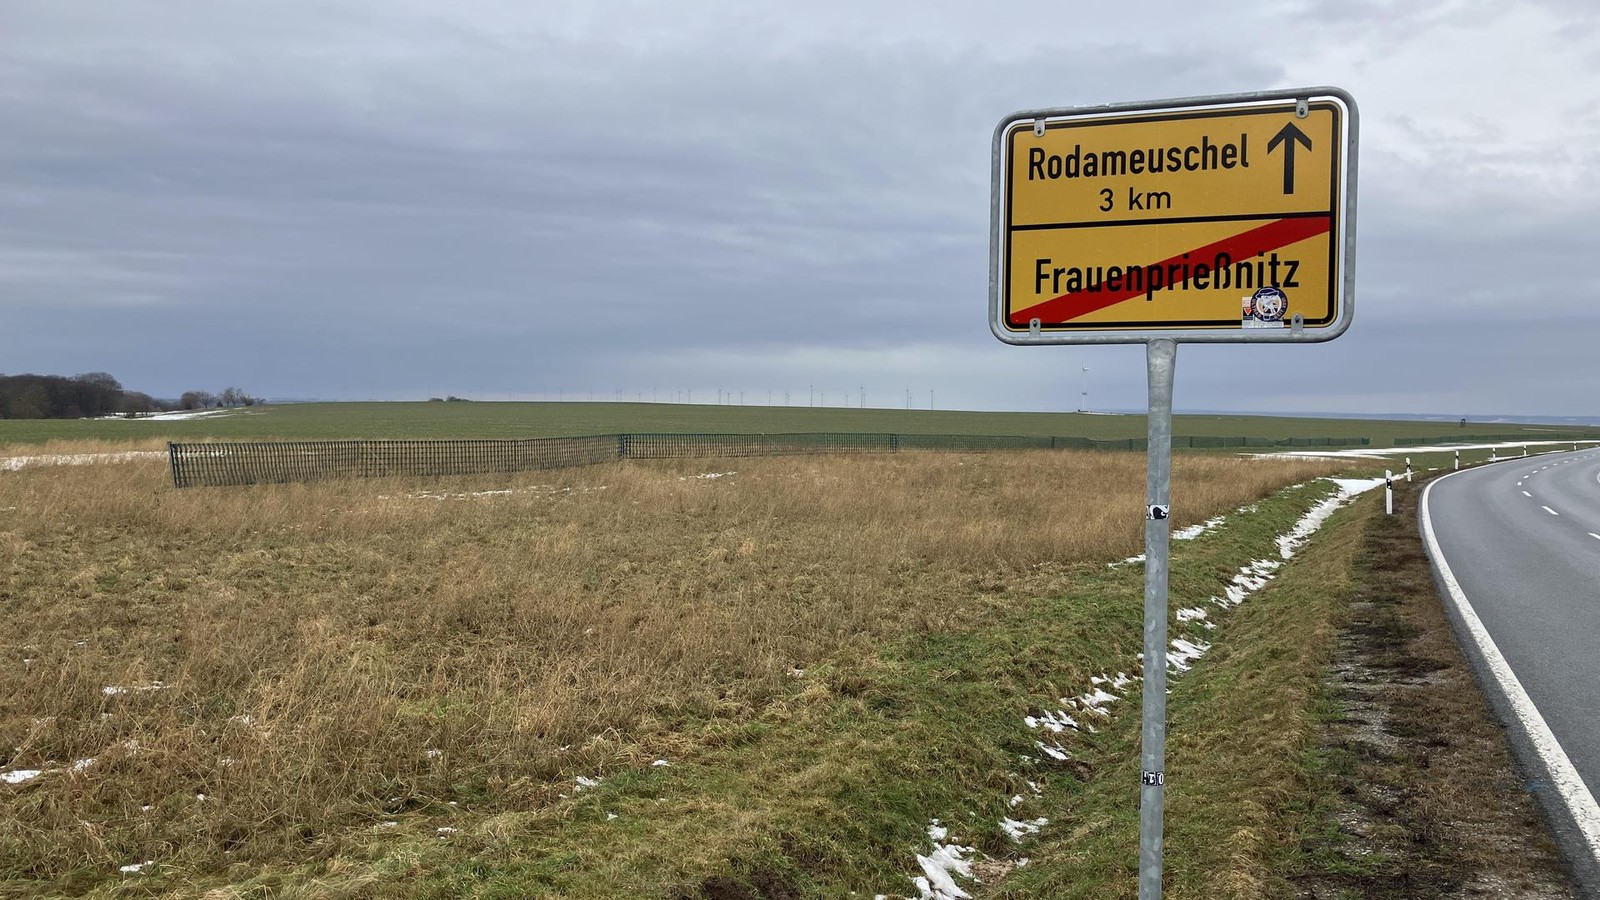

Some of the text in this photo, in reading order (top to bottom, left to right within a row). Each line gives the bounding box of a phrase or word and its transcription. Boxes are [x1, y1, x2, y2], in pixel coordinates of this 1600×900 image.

[1028, 133, 1249, 181] Rodameuschel
[1099, 187, 1171, 212] 3 km
[1035, 251, 1300, 302] Frauenprießnitz
